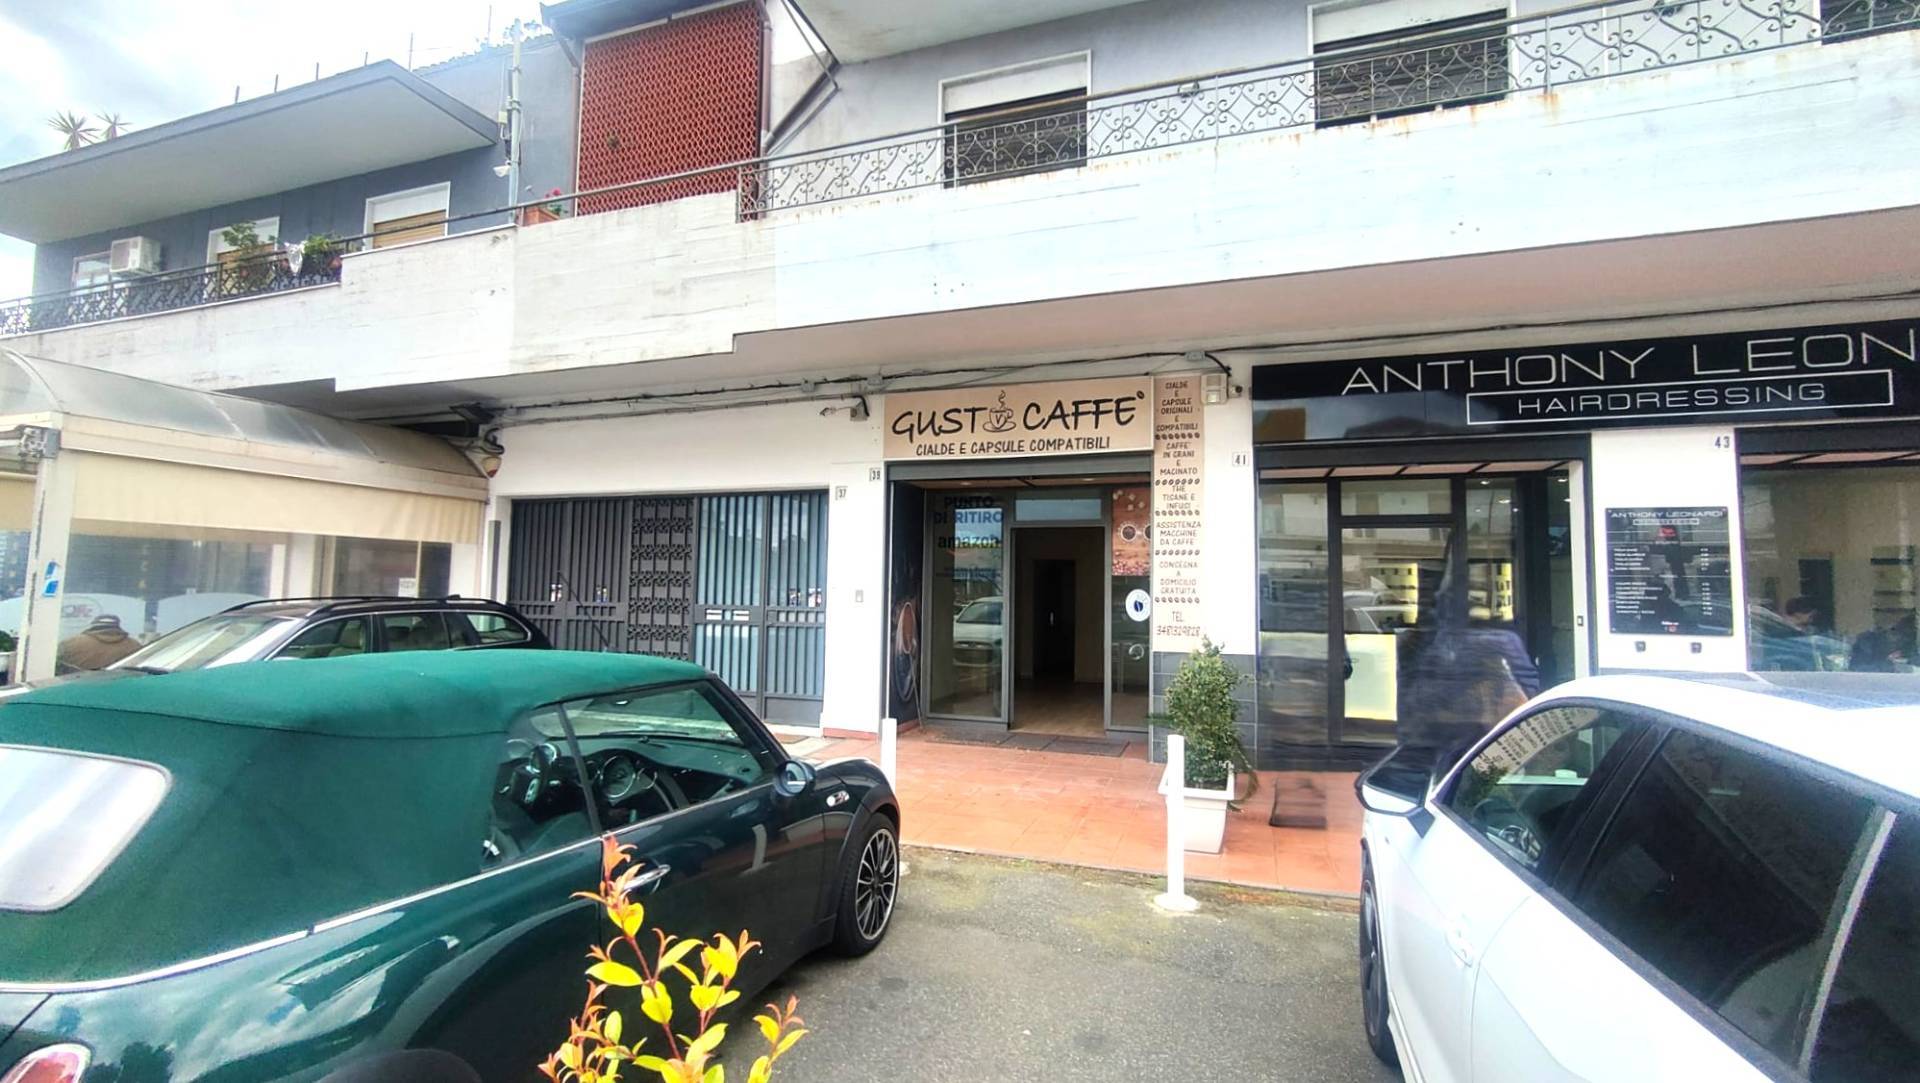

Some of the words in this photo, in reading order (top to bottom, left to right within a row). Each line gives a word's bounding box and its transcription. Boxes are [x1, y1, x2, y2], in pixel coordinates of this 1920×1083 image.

[1341, 346, 1656, 396] ANTHONY
[1165, 380, 1188, 390] CIALDE
[1161, 397, 1192, 406] CAPSULE
[1518, 382, 1826, 416] HAIRDRESSING
[1160, 406, 1193, 415] ORIGINALI
[1156, 423, 1198, 432] COMPATIBILI
[915, 443, 956, 456] CIALDE
[959, 442, 966, 454] E
[970, 439, 1026, 454] CAPSULE
[1029, 436, 1111, 452] COMPATIBILI
[1714, 436, 1730, 449] 43
[1234, 454, 1246, 465] 41
[1160, 467, 1198, 475] MACINATO
[953, 510, 1004, 524] RITIRO
[1156, 521, 1201, 529] ASSISTENZA
[1160, 529, 1197, 537] MACCHINE
[938, 535, 1001, 549] amazon
